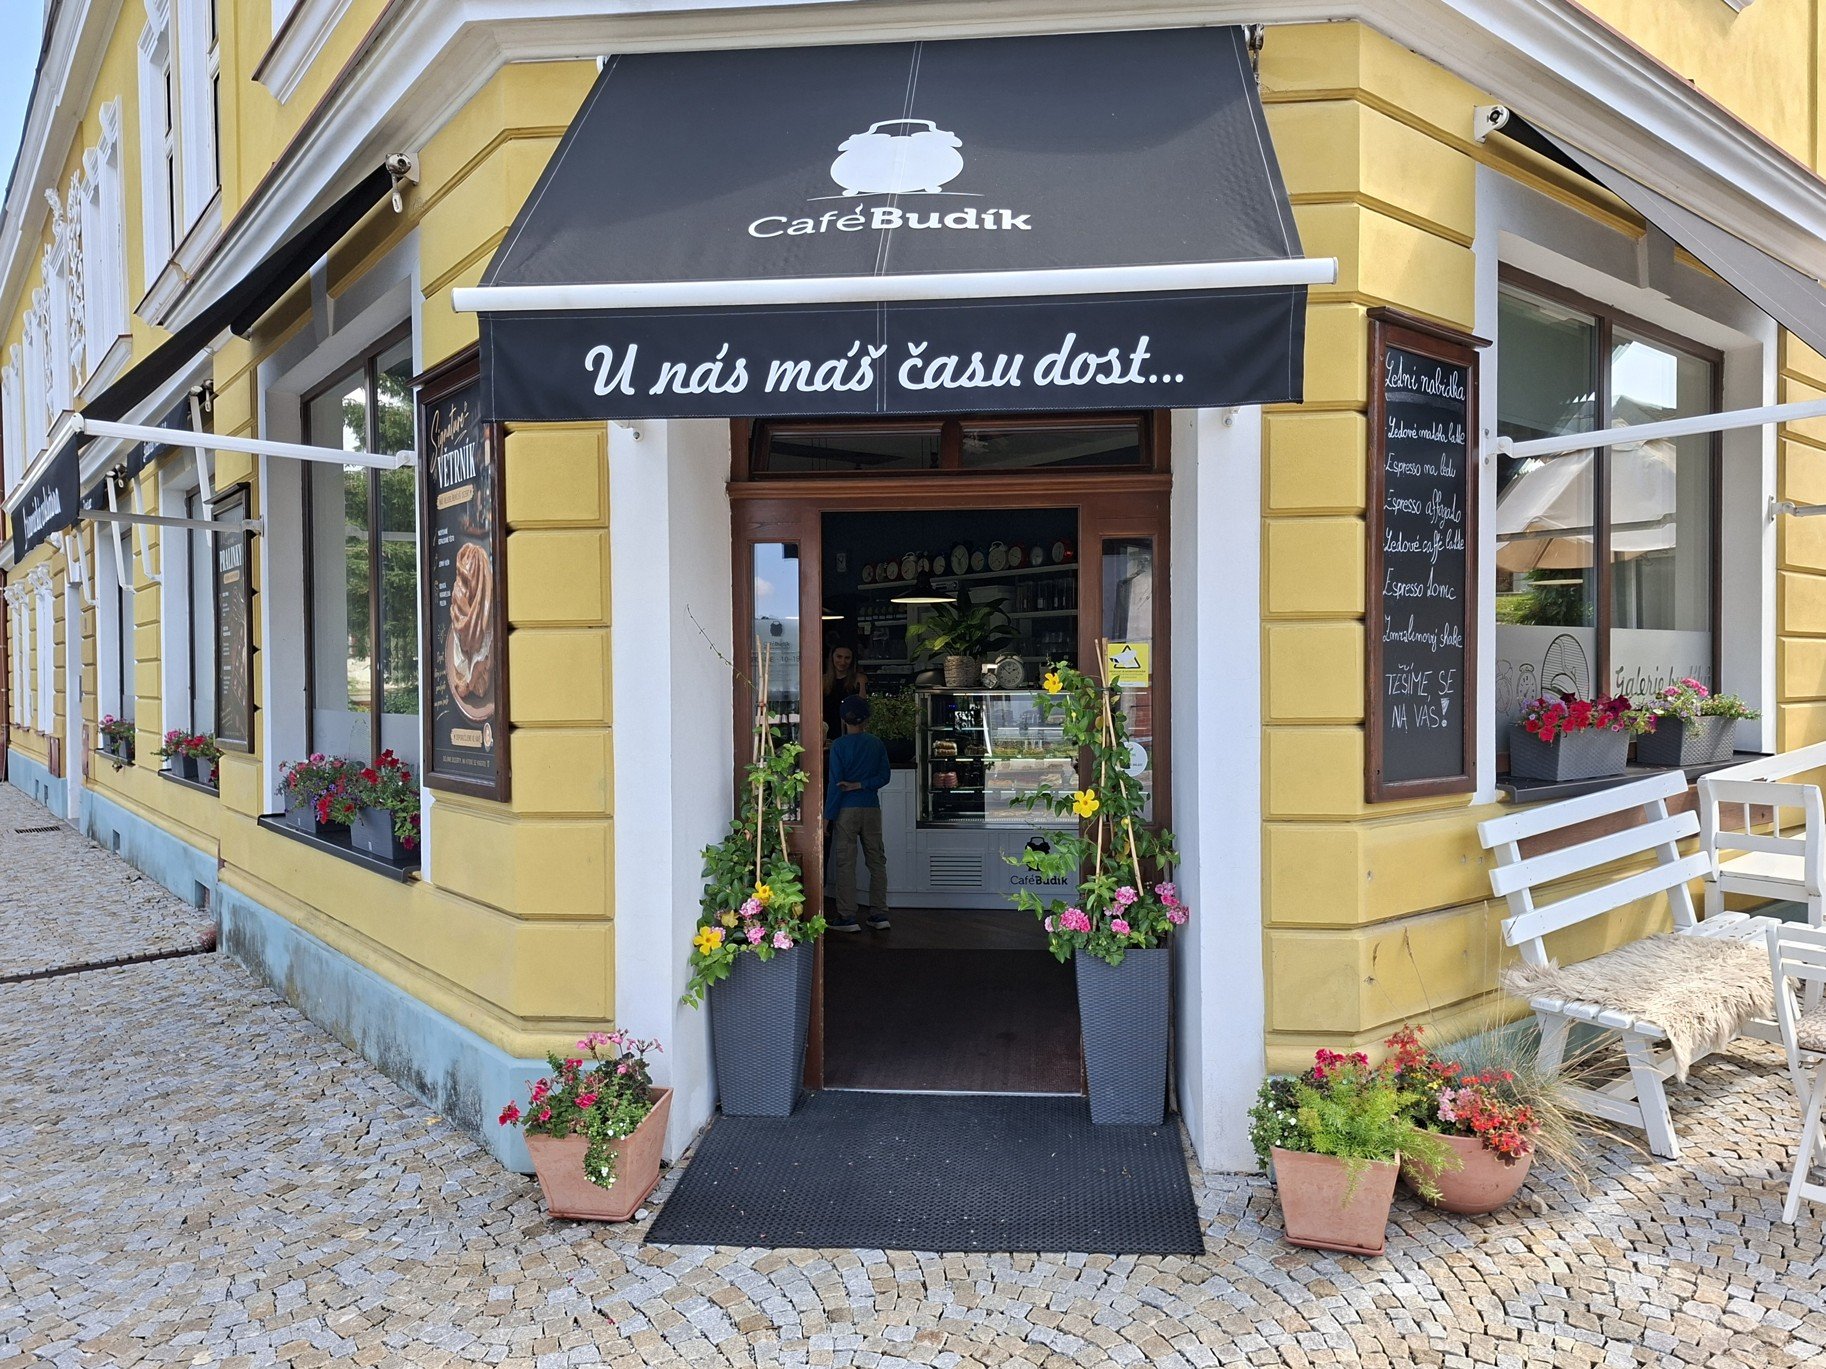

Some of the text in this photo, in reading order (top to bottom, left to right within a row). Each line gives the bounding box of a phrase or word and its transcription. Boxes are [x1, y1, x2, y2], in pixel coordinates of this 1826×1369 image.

[585, 332, 1184, 396] U nás máš času dost...
[437, 437, 476, 489] VĚTRNÍK
[1385, 452, 1456, 478] Espresso na ledu
[1384, 489, 1421, 515] Espresso
[1383, 567, 1423, 599] Espresso
[1440, 622, 1463, 648] shake
[1385, 662, 1457, 696] TĚŠÍME SE
[1615, 665, 1664, 699] Galerie
[1392, 695, 1450, 730] NA VÁS!
